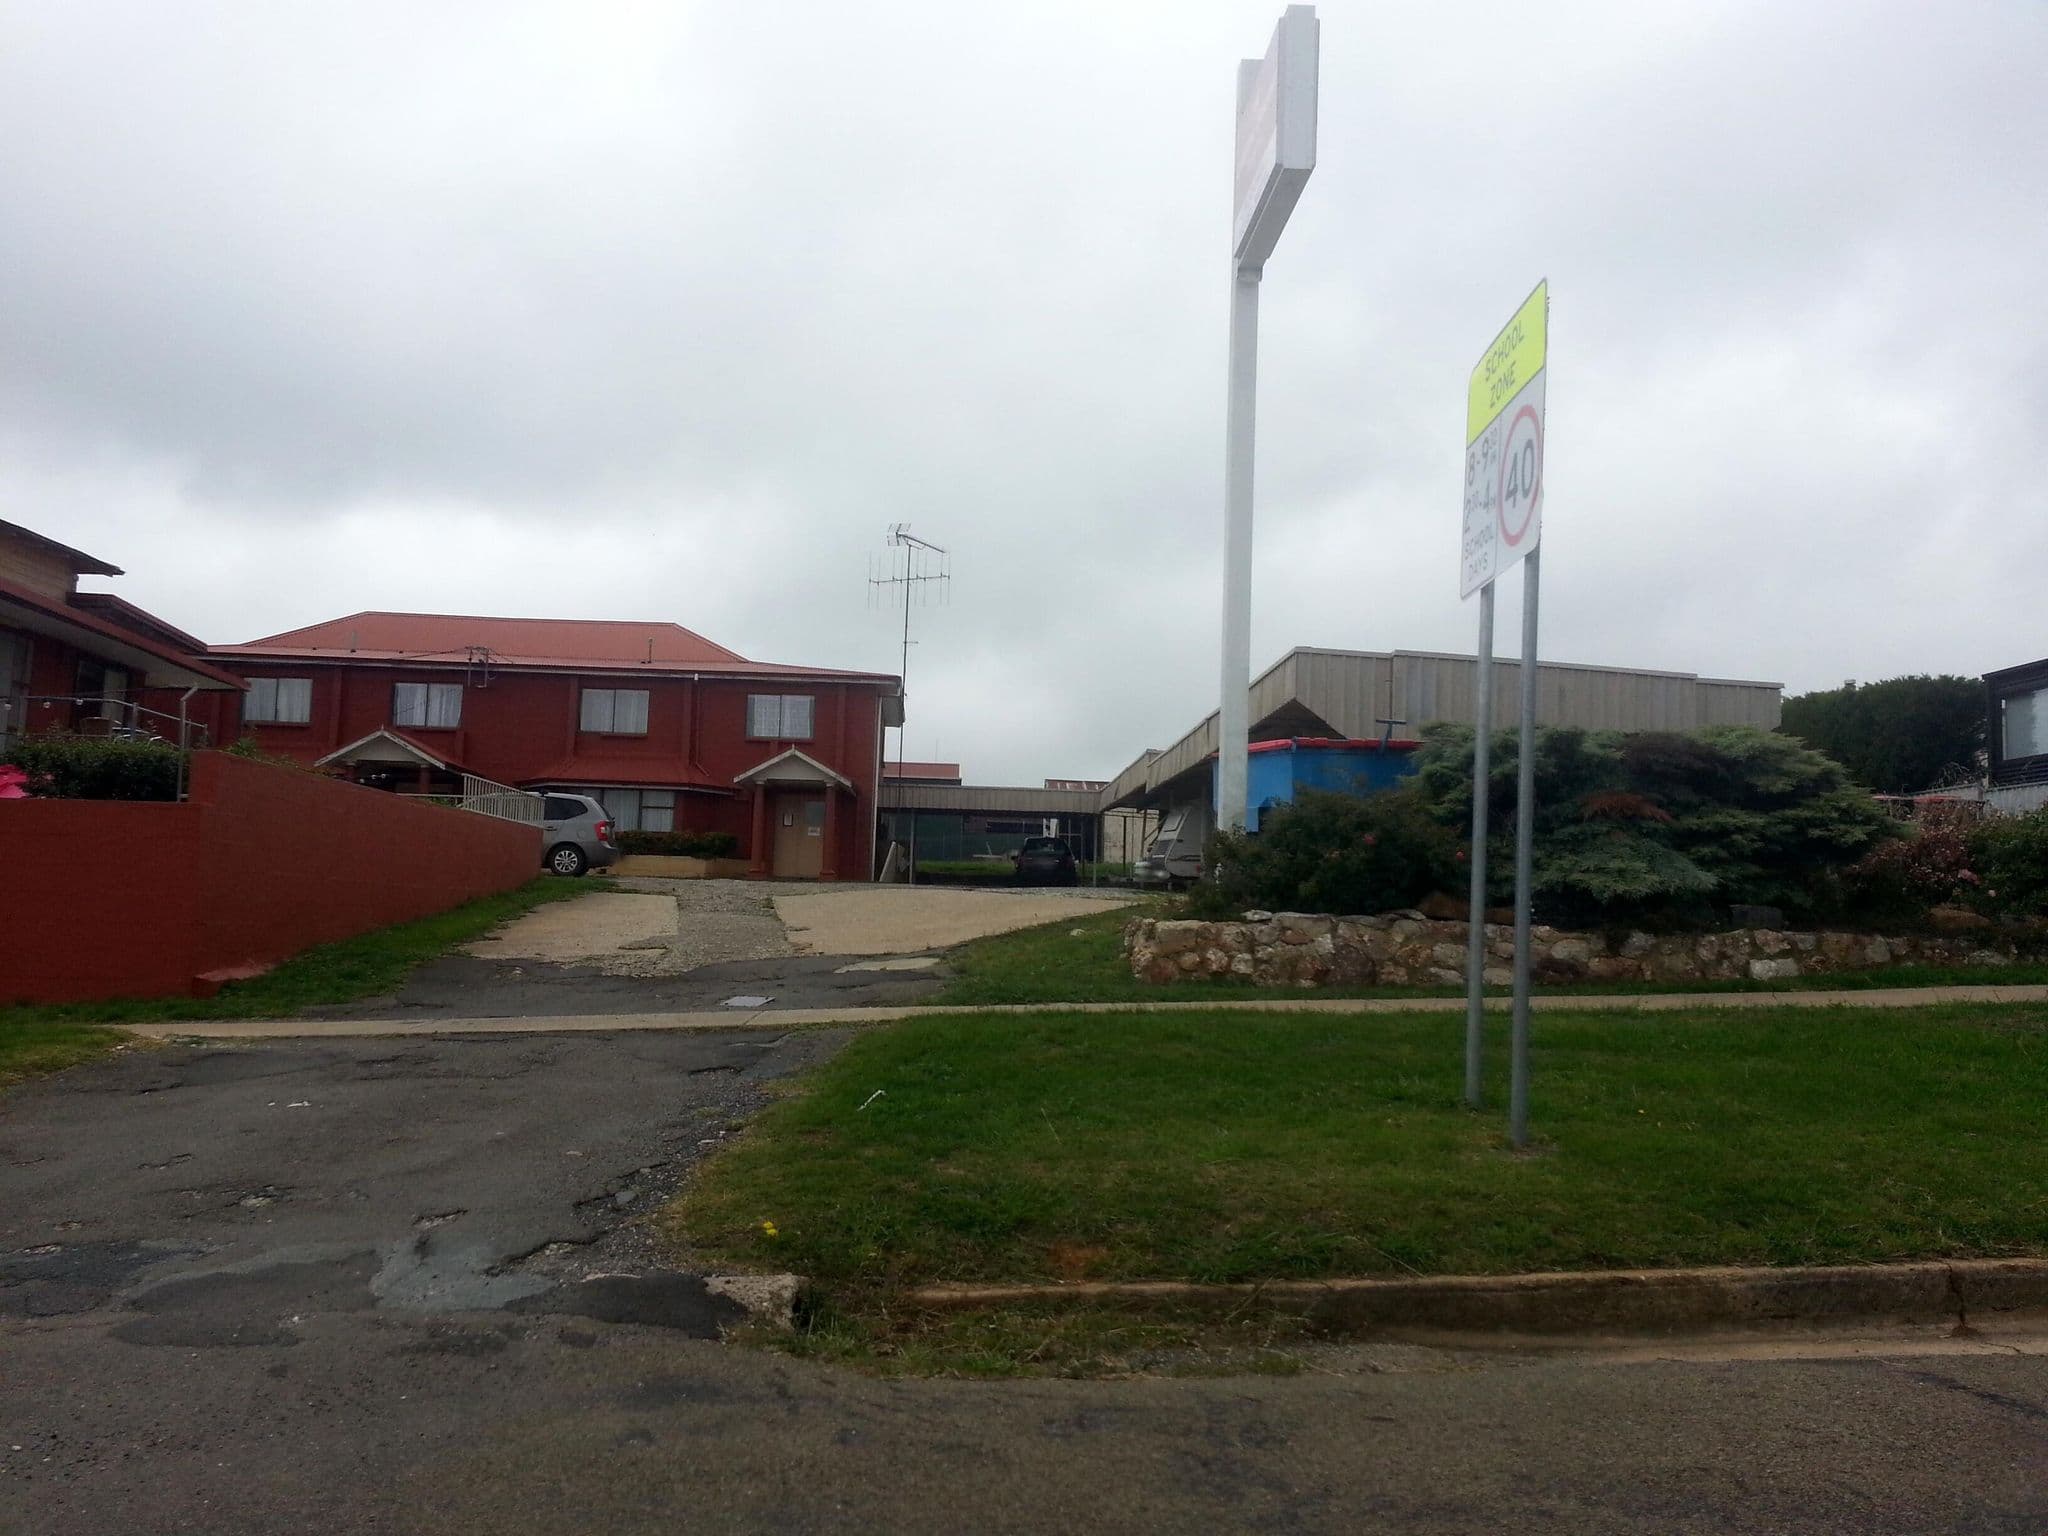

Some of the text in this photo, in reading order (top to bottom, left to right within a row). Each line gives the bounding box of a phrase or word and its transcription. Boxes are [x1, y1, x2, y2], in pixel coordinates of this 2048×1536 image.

[1485, 320, 1525, 382] SCHOOL
[1489, 360, 1517, 408] ZONE
[1505, 439, 1535, 509] 40
